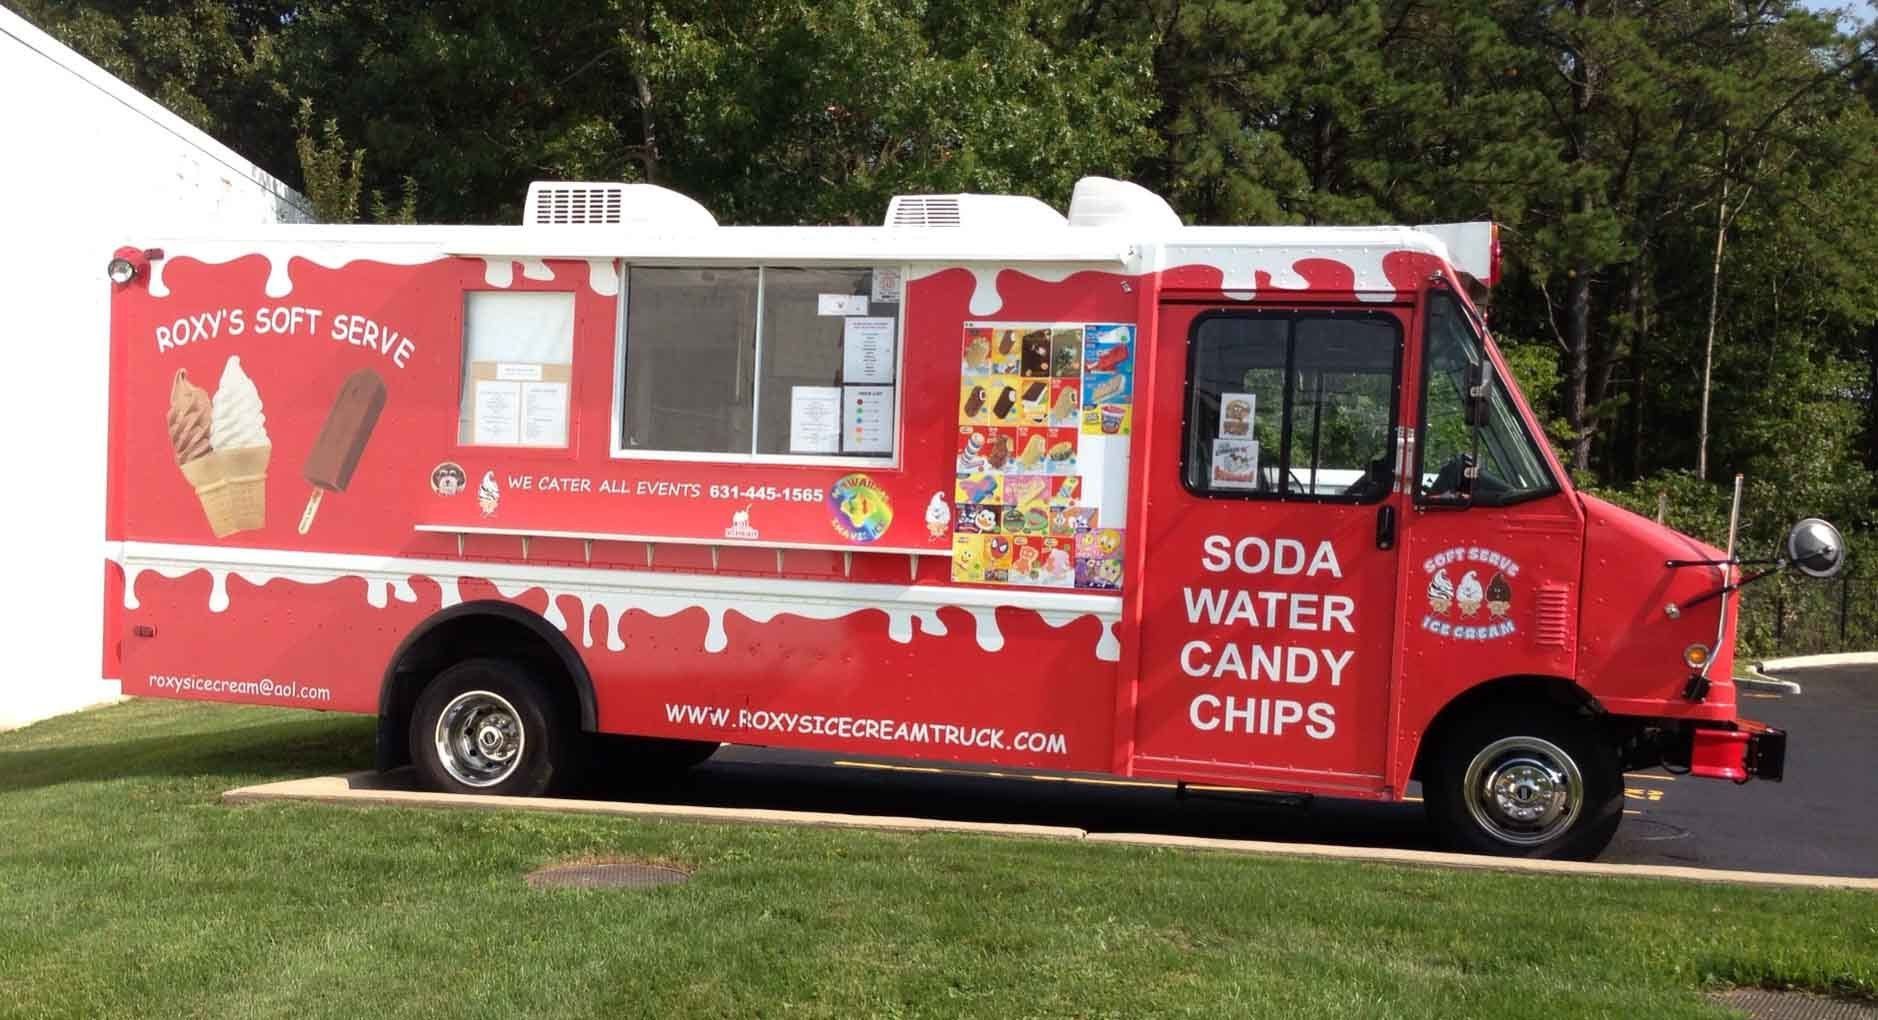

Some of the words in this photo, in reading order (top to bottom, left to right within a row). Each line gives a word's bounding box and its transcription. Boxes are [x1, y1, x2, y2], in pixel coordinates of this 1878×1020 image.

[156, 308, 245, 352] ROXY'S
[254, 307, 322, 335] SOFT
[331, 314, 416, 368] SERVE
[508, 475, 533, 489] WE
[538, 476, 591, 492] CATER
[599, 479, 631, 494] ALL
[636, 481, 702, 498] EVENTS
[709, 484, 824, 502] 631-445-1565
[1202, 534, 1343, 578] SODA
[1423, 547, 1466, 574] SOFT
[1467, 546, 1521, 577] SERVE
[1183, 587, 1355, 633] WATER
[1422, 615, 1452, 636] ICE
[1453, 618, 1516, 640] CREAM
[1180, 640, 1355, 686] CANDY
[149, 674, 331, 701] roxysicecream@aol.com
[665, 703, 1068, 755] WWW.ROXYSICECREAMTRUCK.COM
[1189, 693, 1336, 740] CHIPS
